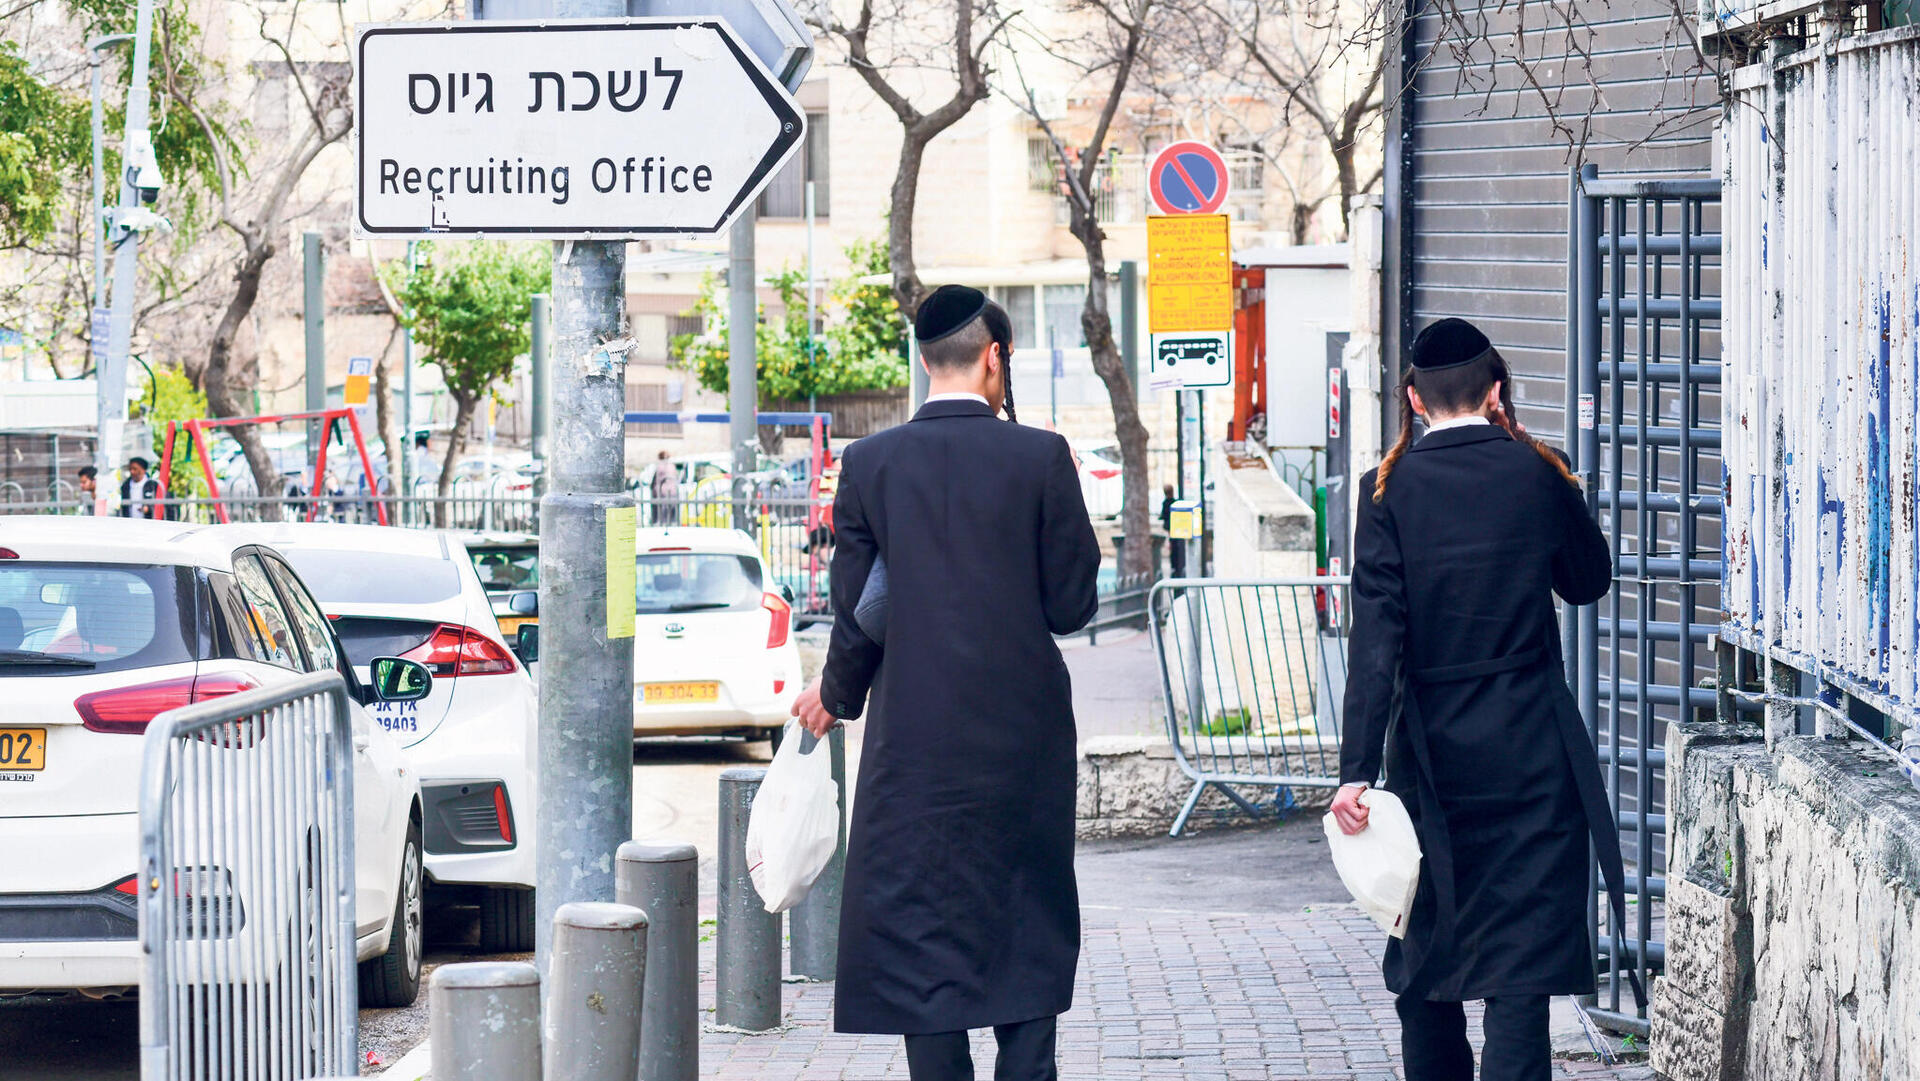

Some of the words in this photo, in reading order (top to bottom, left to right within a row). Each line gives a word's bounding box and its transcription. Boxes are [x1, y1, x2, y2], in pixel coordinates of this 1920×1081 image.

[408, 71, 494, 115] גיוס
[528, 57, 683, 113] לשכת
[380, 157, 570, 205] Recruiting
[592, 156, 713, 194] Office
[1155, 271, 1201, 281] ALIGHTING
[1202, 270, 1224, 280] ONLY
[1204, 260, 1226, 269] AND
[0, 733, 32, 764] 02
